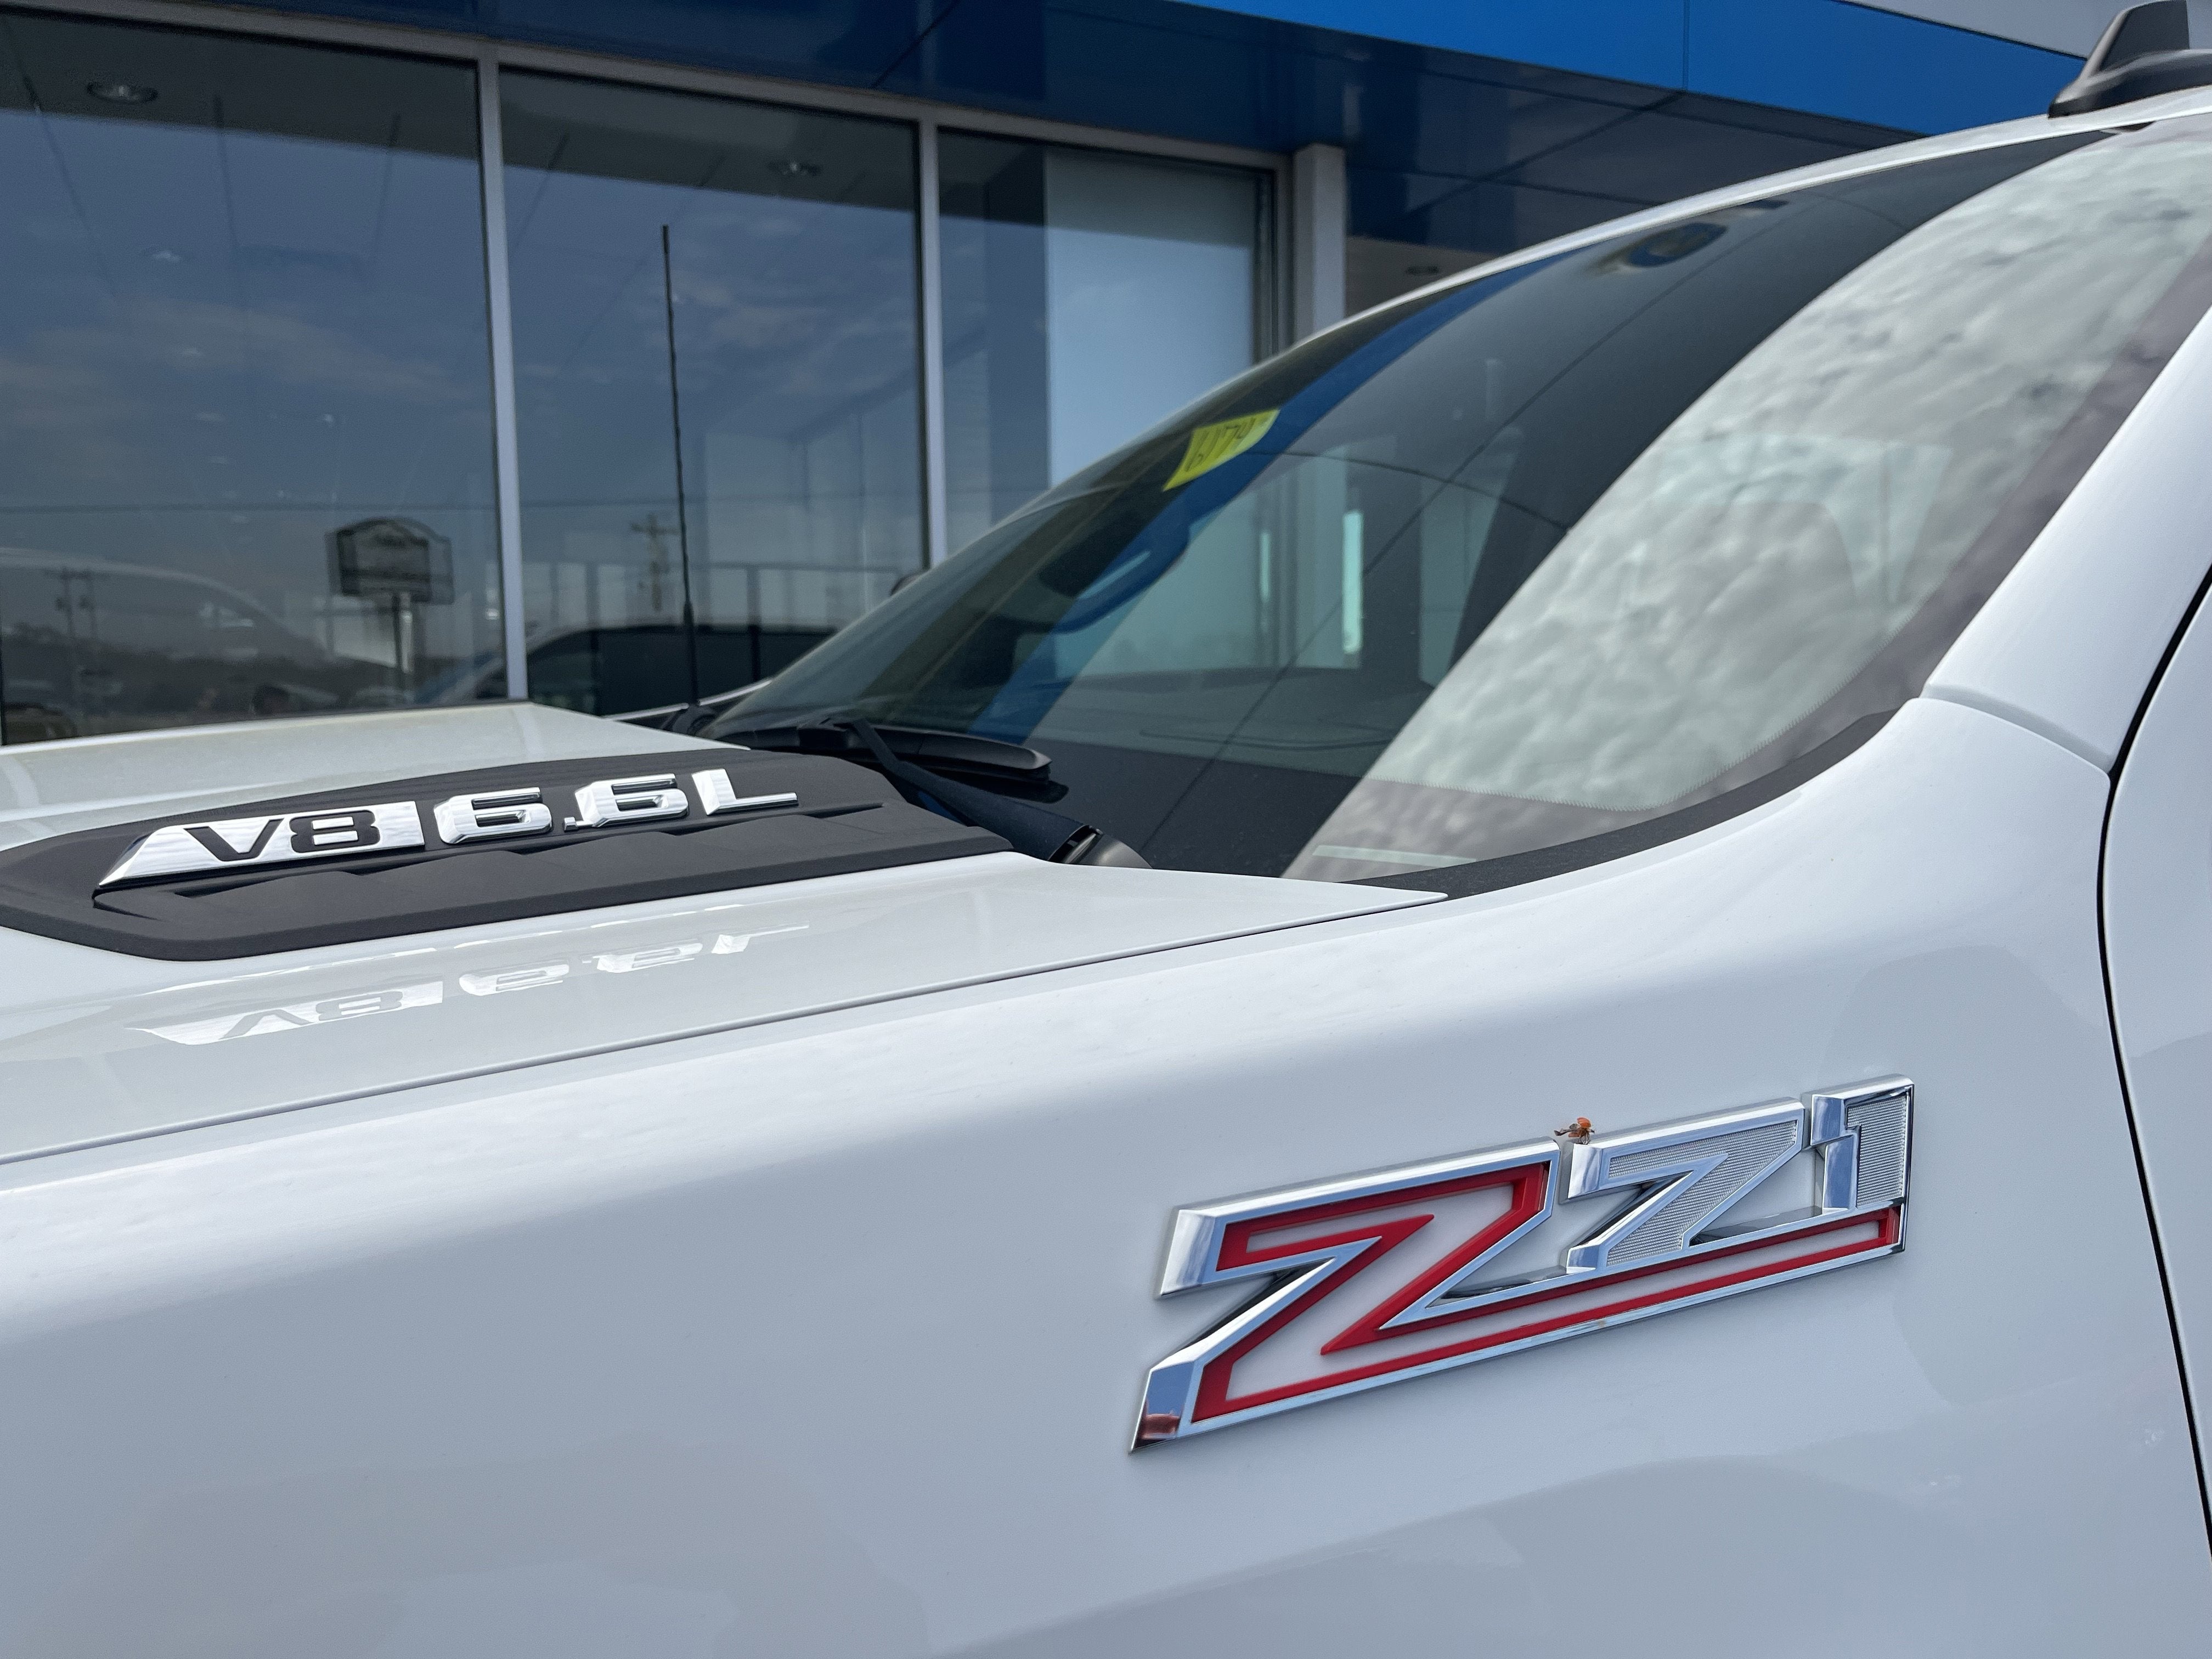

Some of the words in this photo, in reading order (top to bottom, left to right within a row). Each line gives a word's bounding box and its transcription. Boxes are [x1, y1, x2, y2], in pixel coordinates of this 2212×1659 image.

[183, 809, 382, 863] V8
[433, 768, 798, 845] 6.6L
[1129, 1074, 1915, 1454] Z71
